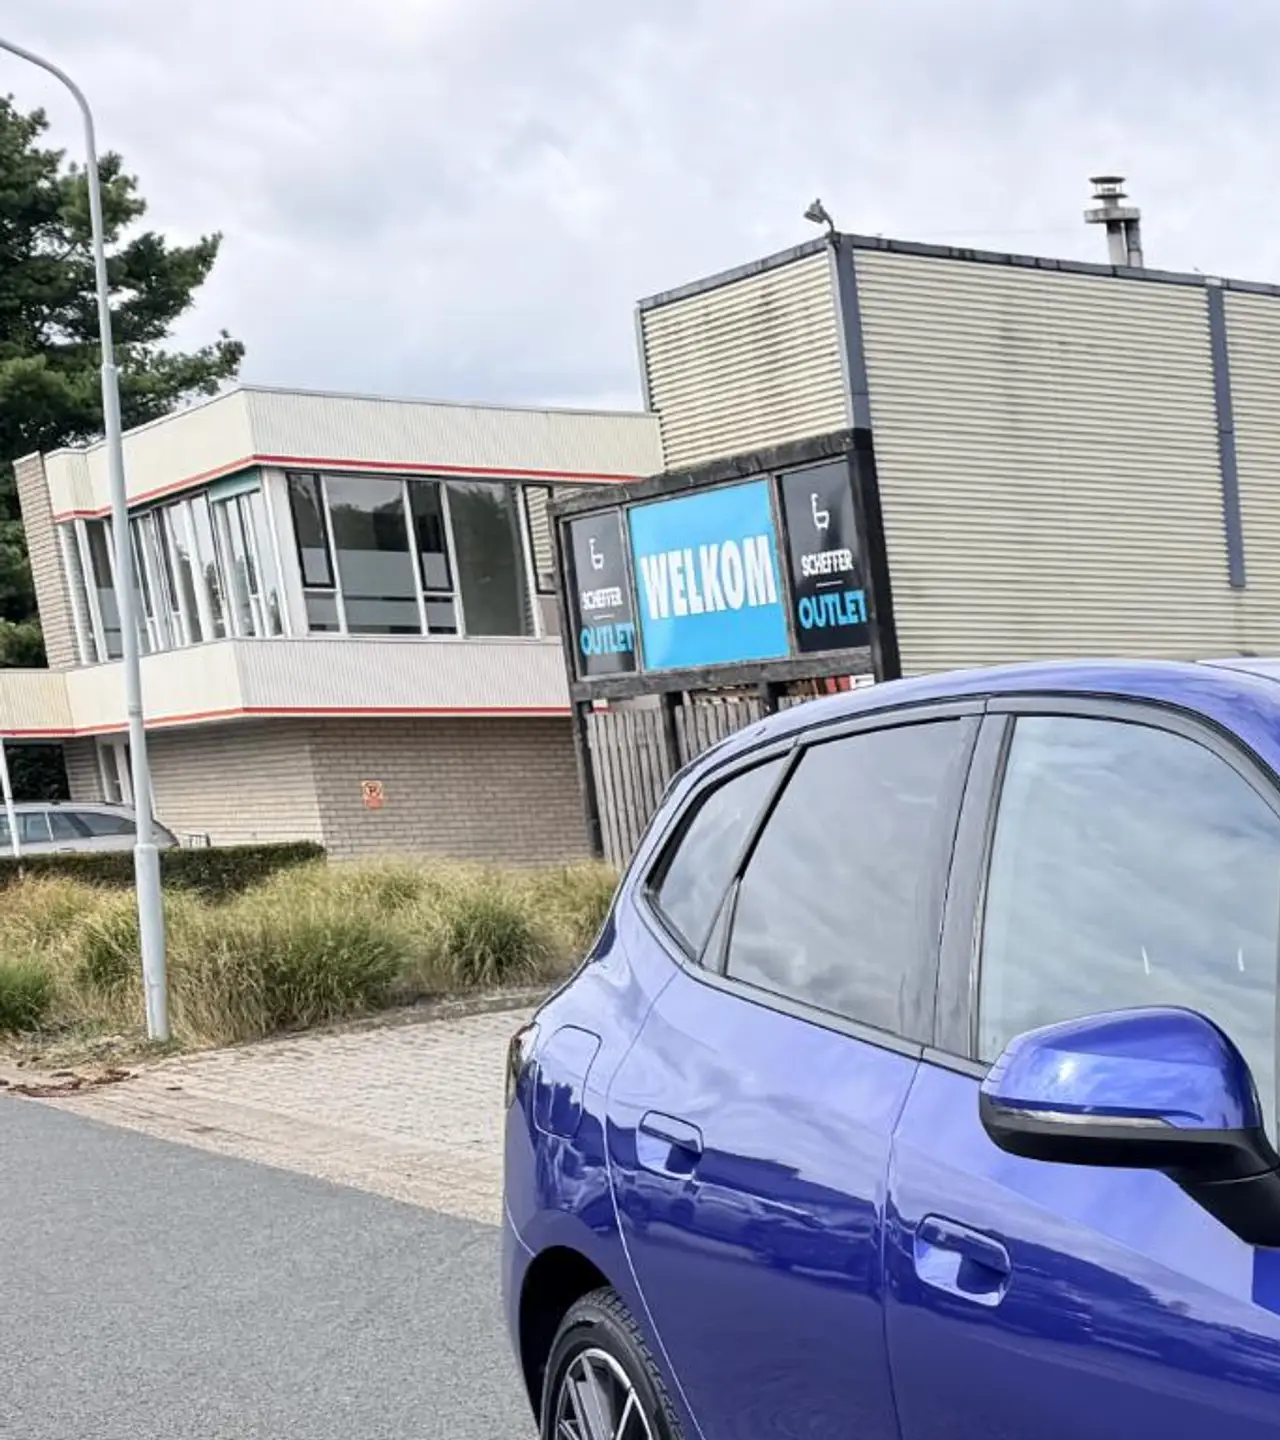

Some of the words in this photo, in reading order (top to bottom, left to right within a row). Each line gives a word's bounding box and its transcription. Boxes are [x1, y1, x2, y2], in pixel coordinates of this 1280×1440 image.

[640, 534, 778, 620] WELKOM
[801, 548, 853, 577] SCHEFFER
[581, 585, 623, 611] SCHEFFER
[798, 589, 868, 629] OUTLET
[580, 622, 635, 656] OUTLET
